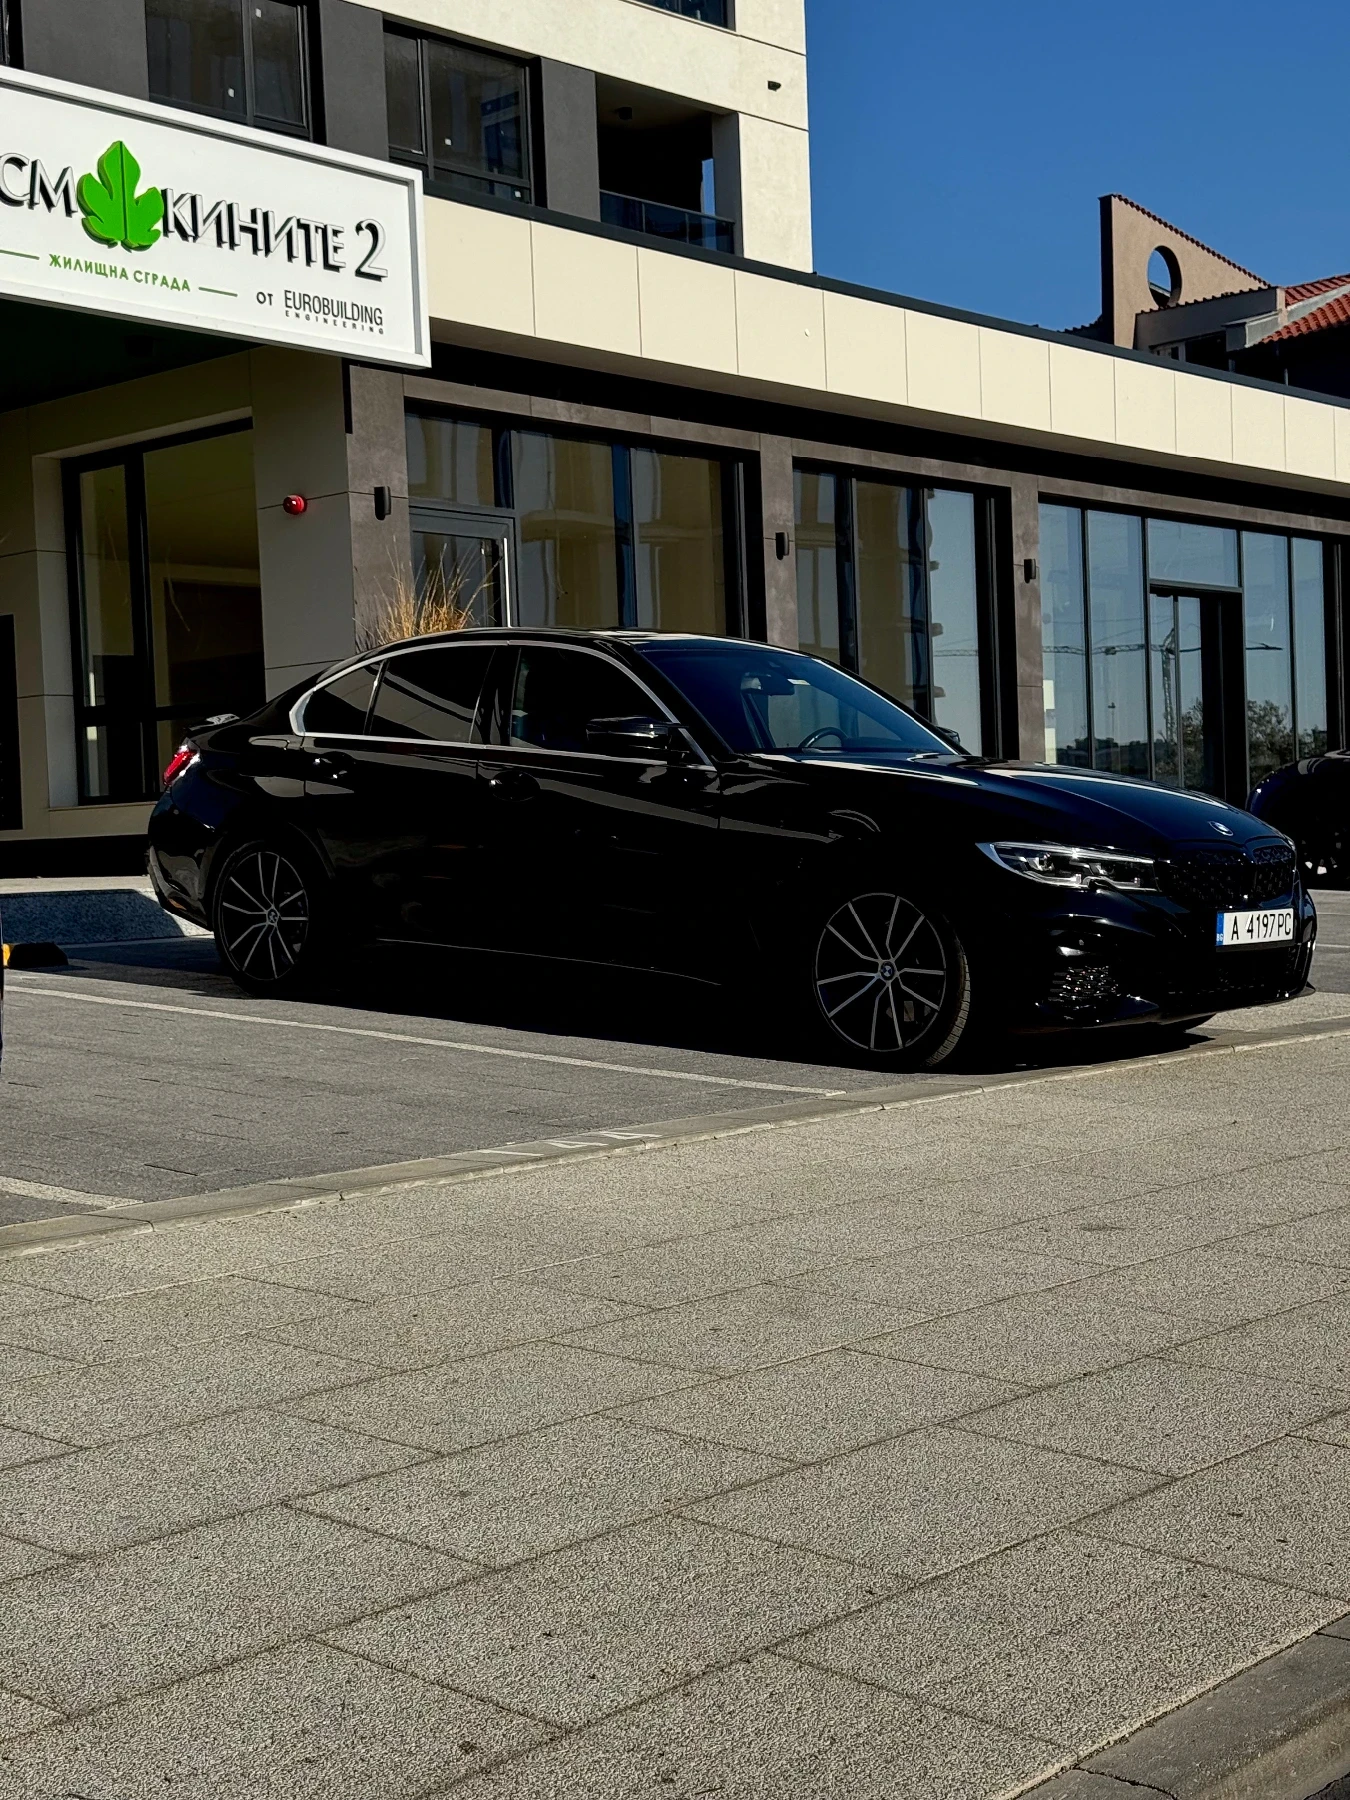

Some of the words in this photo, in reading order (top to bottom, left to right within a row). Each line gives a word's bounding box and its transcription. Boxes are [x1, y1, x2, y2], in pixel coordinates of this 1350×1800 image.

[355, 218, 389, 282] 2
[48, 253, 129, 280] ЖИЛИЩНА
[133, 269, 191, 293] СГРАДА
[284, 289, 383, 327] EUROBUILDING
[284, 309, 384, 335] ENGINEERING
[1231, 915, 1240, 941] A
